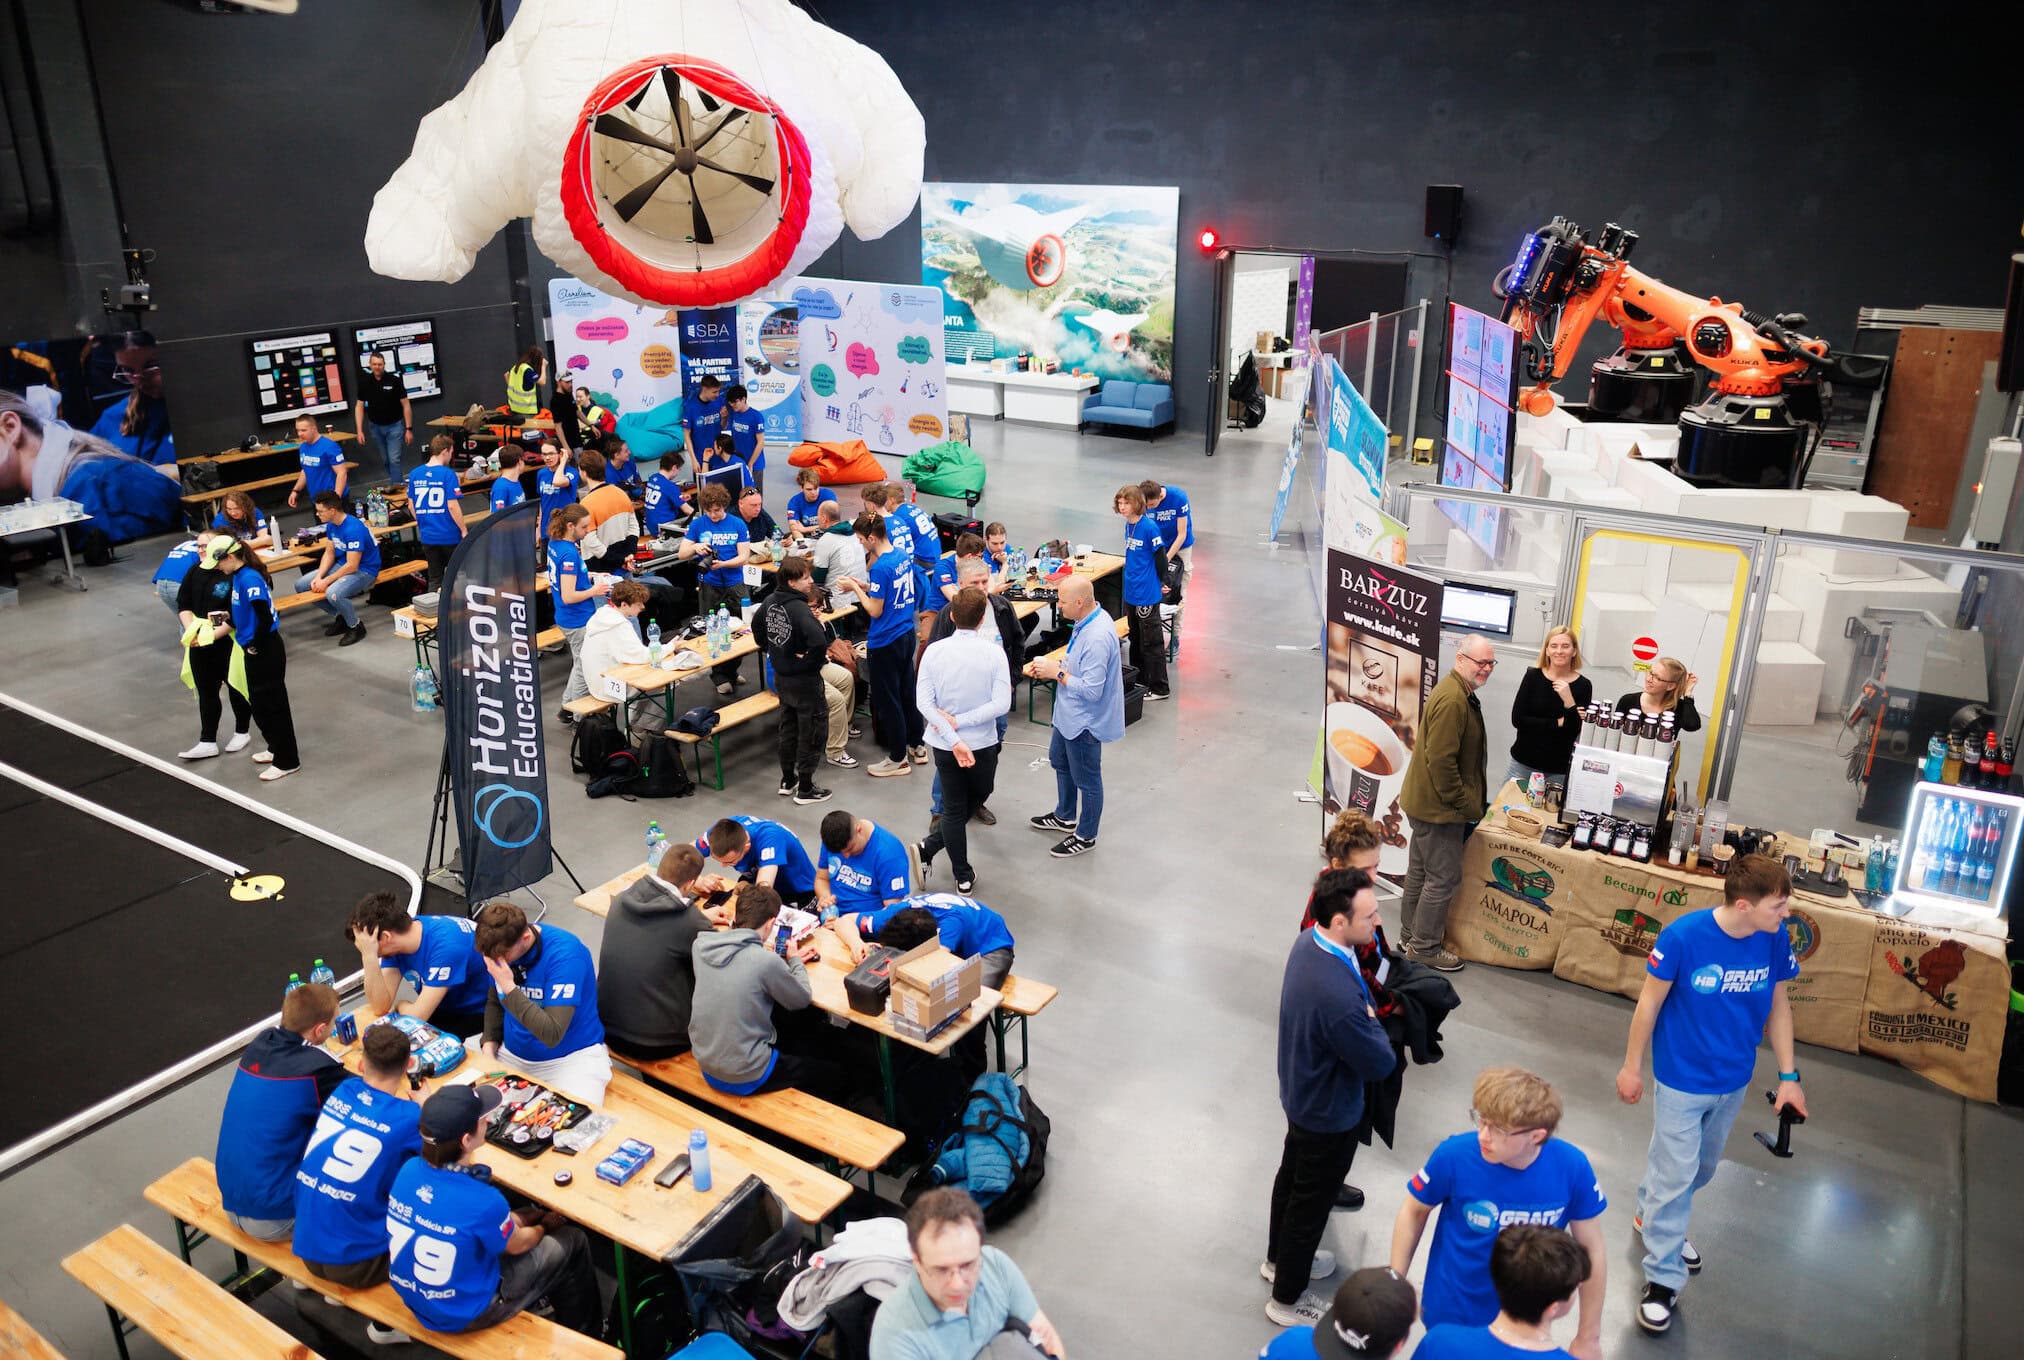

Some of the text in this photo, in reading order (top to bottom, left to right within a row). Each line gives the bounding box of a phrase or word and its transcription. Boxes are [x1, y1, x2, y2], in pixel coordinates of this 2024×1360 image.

[696, 323, 730, 338] SBA
[701, 357, 732, 367] PARTNER
[705, 366, 726, 375] SVETE
[1730, 358, 1760, 367] KUKA
[414, 486, 445, 508] 70
[712, 532, 739, 541] GRAND
[747, 567, 757, 576] 83
[1339, 567, 1428, 617] BARZUZ
[400, 619, 408, 629] 70
[1343, 611, 1420, 647] www.kafe.sk
[463, 584, 509, 775] Horizon
[501, 592, 539, 778] Educational
[610, 681, 621, 692] 73
[1510, 846, 1521, 854] DE
[1521, 849, 1549, 866] COSTA
[1546, 861, 1565, 875] RICA
[839, 864, 873, 886] GRAND
[1603, 875, 1657, 900] Becamo
[1479, 893, 1550, 934] AMAPOLA
[427, 966, 452, 981] 79
[1723, 966, 1770, 983] GRAND
[551, 983, 576, 1000] 79
[1720, 982, 1753, 994] PRIX
[303, 1112, 383, 1184] 79
[386, 1215, 457, 1287] 79
[1295, 1308, 1321, 1321] HOKA
